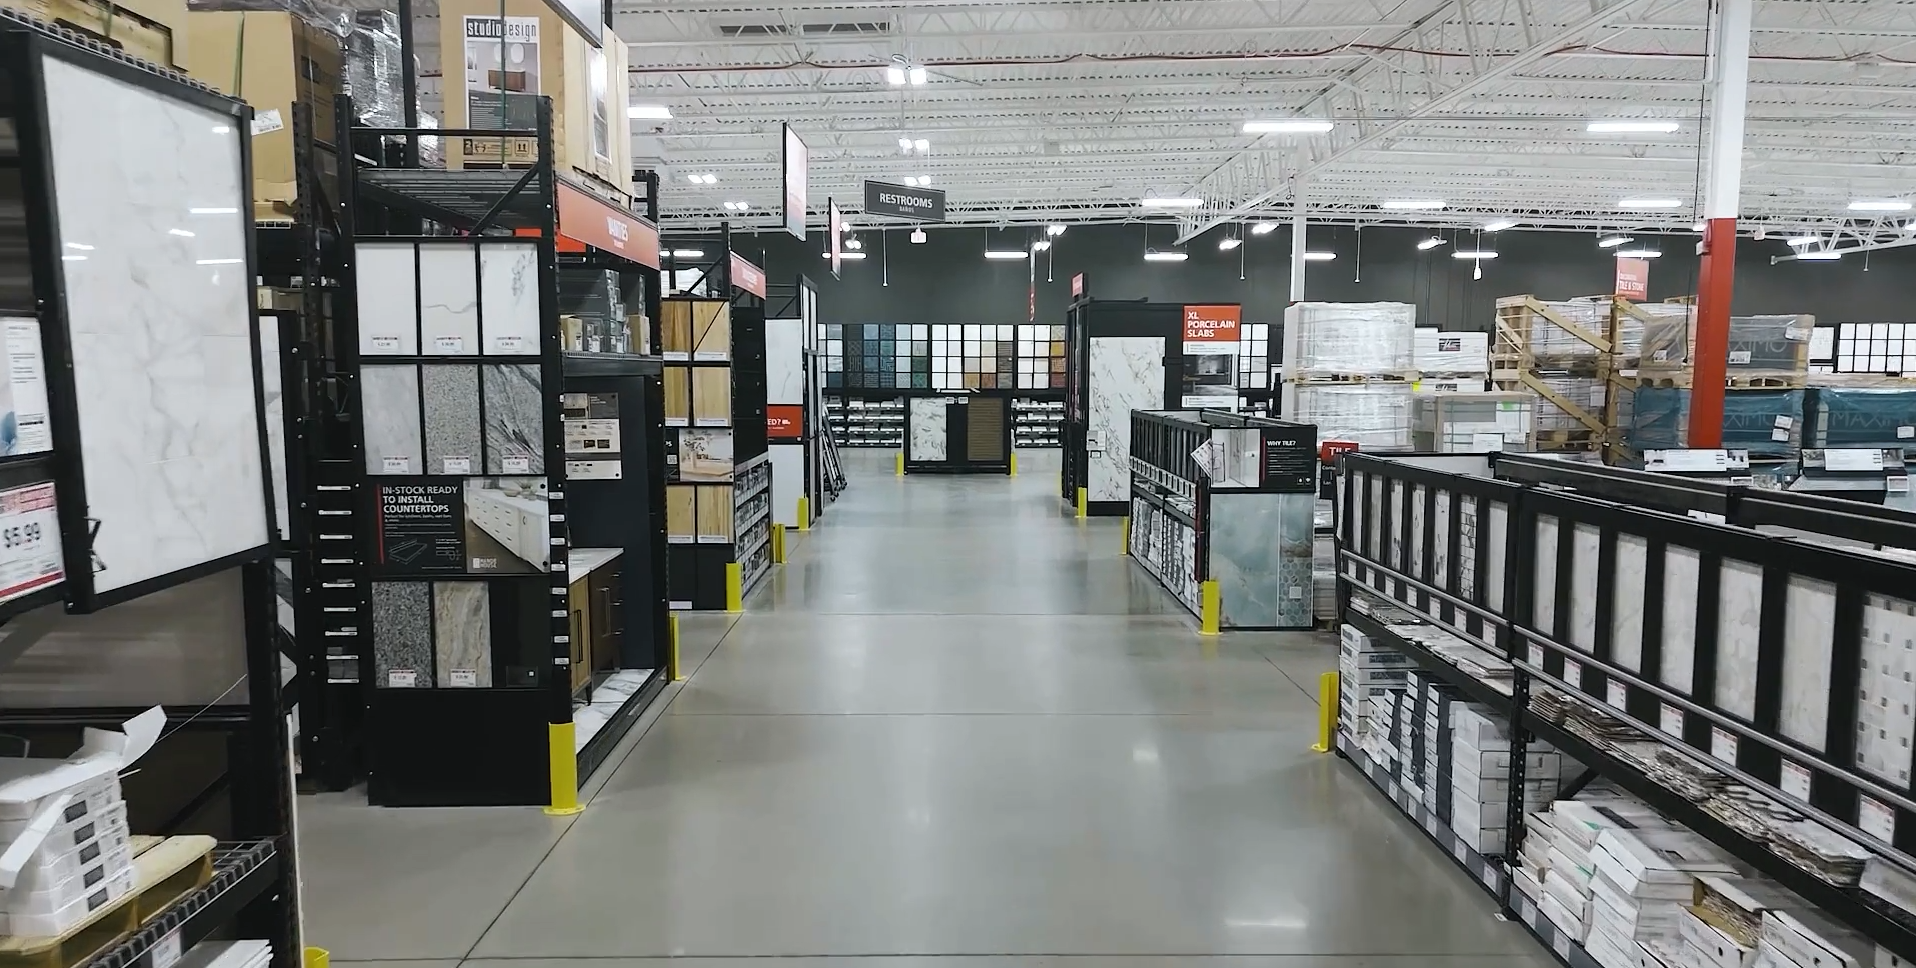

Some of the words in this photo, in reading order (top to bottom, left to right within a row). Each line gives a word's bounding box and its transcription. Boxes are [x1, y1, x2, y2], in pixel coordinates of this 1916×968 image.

[879, 192, 933, 209] RESTROOMS
[1187, 311, 1200, 320] XL
[1187, 320, 1236, 329] PORCELAIN
[1187, 329, 1215, 338] SLABS
[382, 486, 425, 494] IN-STOCK
[427, 486, 458, 494] READY
[383, 495, 396, 504] TO
[397, 495, 434, 504] INSTALL
[383, 504, 450, 513] COUNTERTOPS
[4, 522, 41, 549] $5.99
